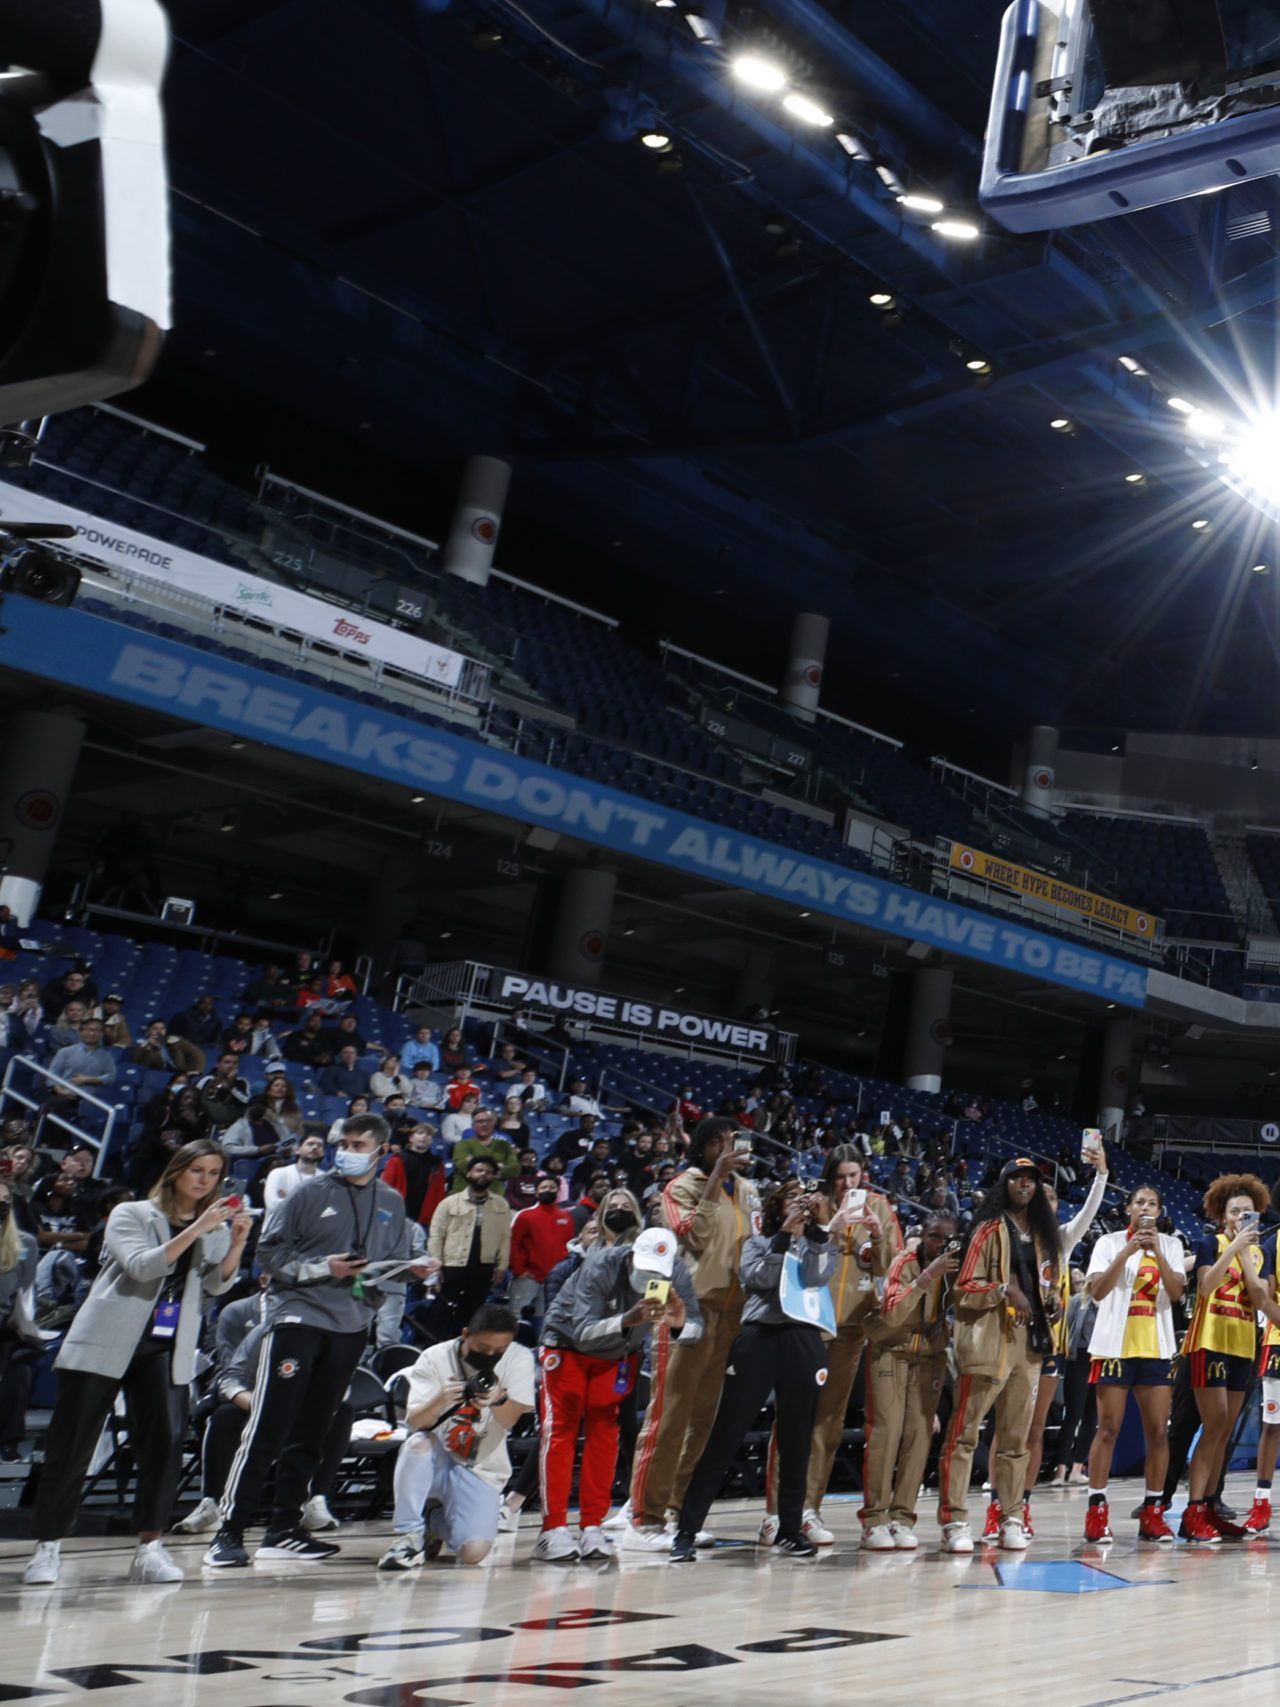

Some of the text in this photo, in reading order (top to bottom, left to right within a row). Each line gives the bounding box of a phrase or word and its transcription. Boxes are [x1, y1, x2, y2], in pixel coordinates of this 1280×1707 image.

[76, 525, 173, 571] POWERADE
[273, 551, 422, 618] 225 226
[109, 643, 460, 784] BREAKS
[463, 757, 666, 847] DON'T
[666, 826, 880, 916] ALWAYS
[883, 890, 996, 952] HAVE
[1001, 931, 1052, 970] TO
[1053, 947, 1103, 986] BE
[1102, 962, 1148, 1000] FA
[427, 839, 521, 877] 124 125
[984, 858, 1130, 926] WHERE HYPE BECOMES LEGACY
[828, 951, 889, 978] 125 126
[501, 975, 770, 1052] PAUSE IS POWER
